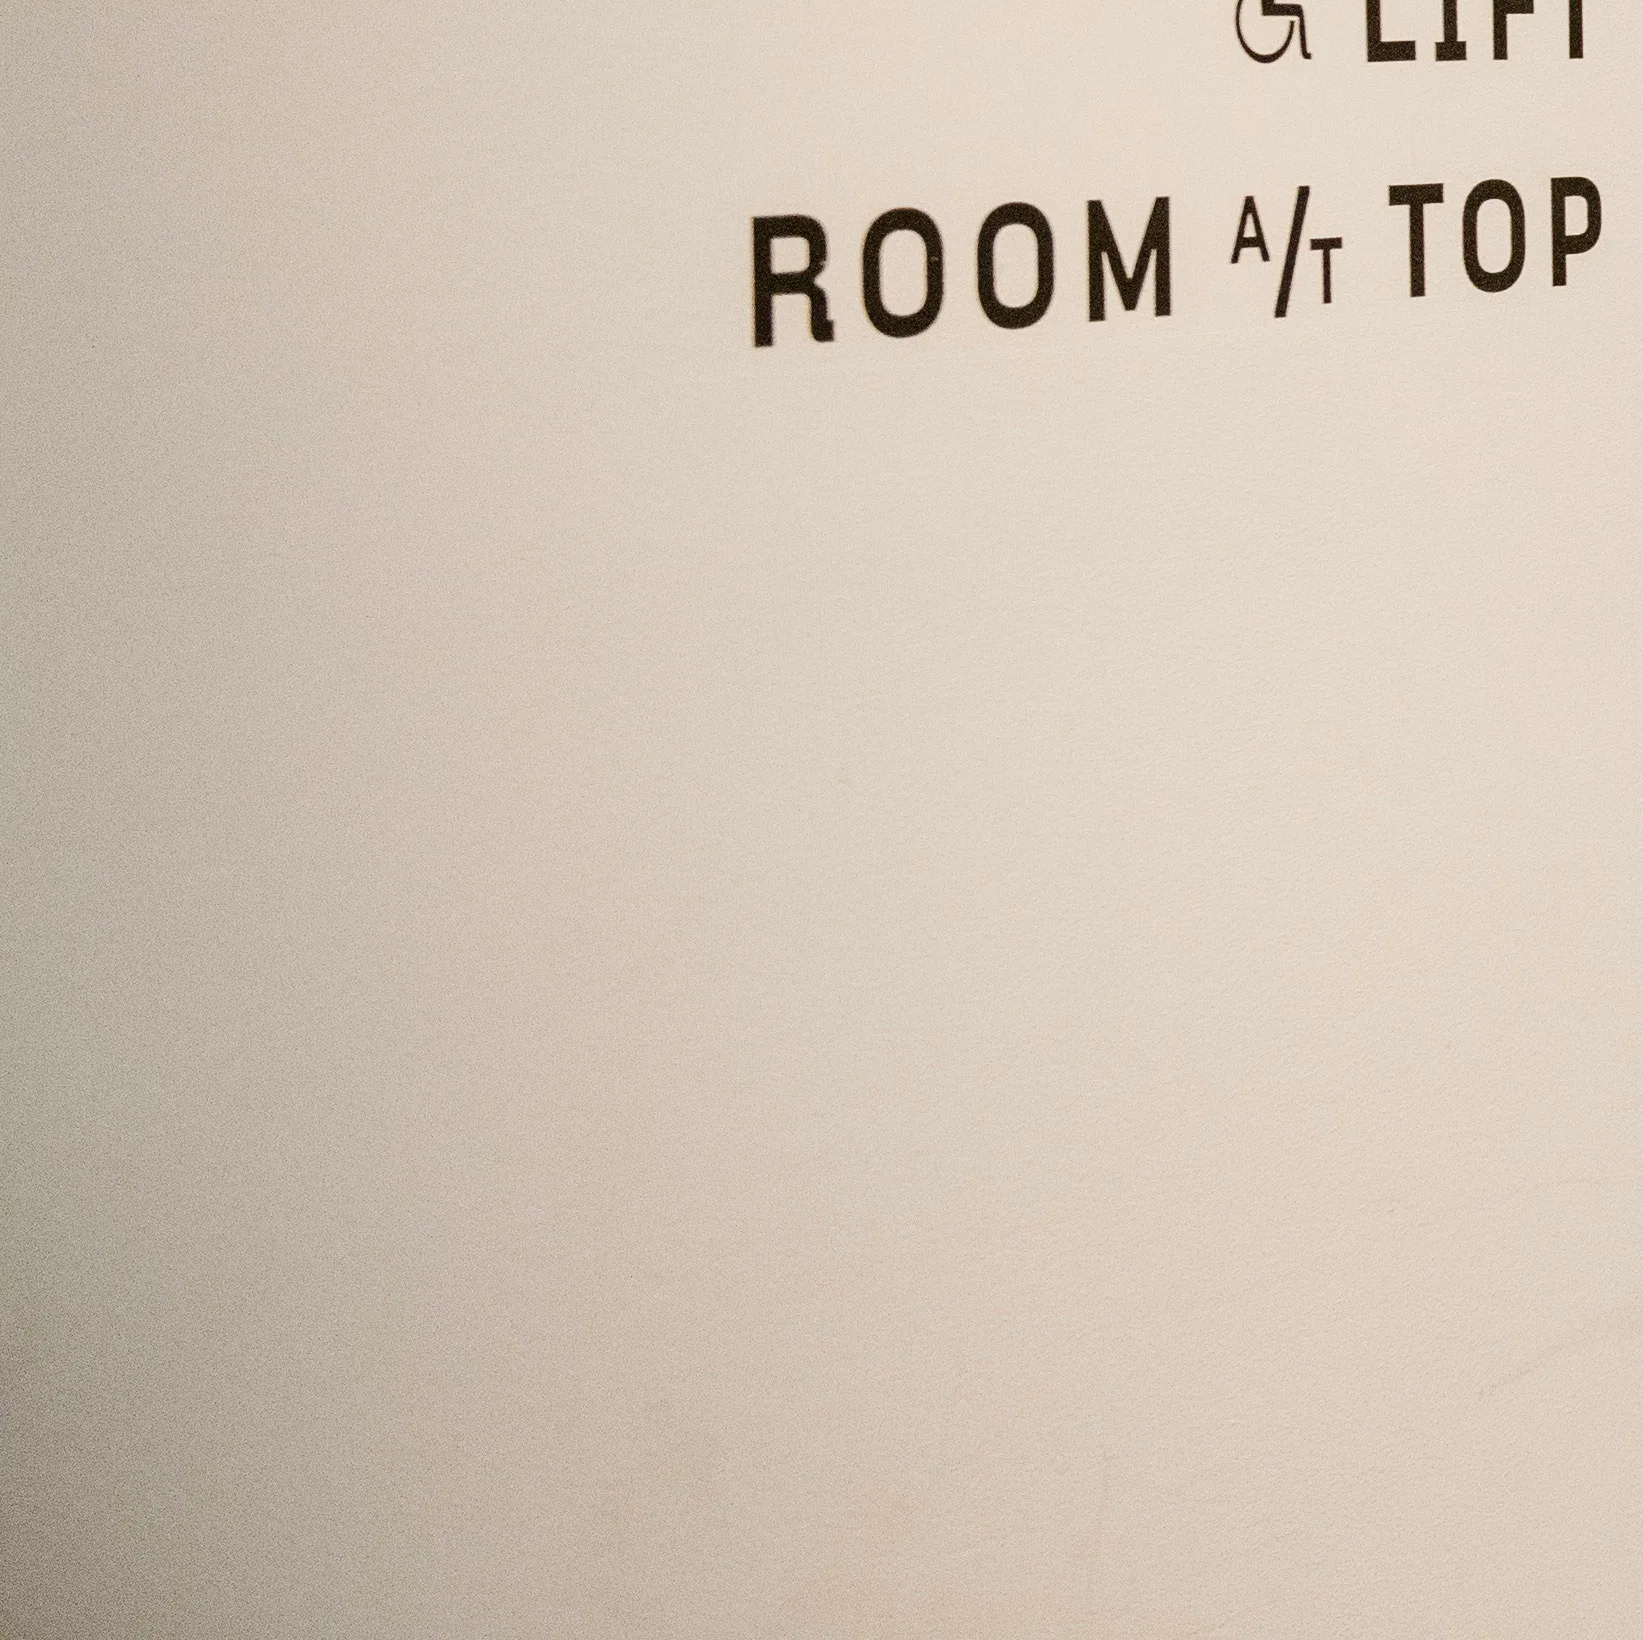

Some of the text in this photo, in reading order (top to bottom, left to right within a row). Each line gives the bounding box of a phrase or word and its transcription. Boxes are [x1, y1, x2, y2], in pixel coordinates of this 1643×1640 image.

[752, 176, 1602, 348] ROOM A/T TOP
